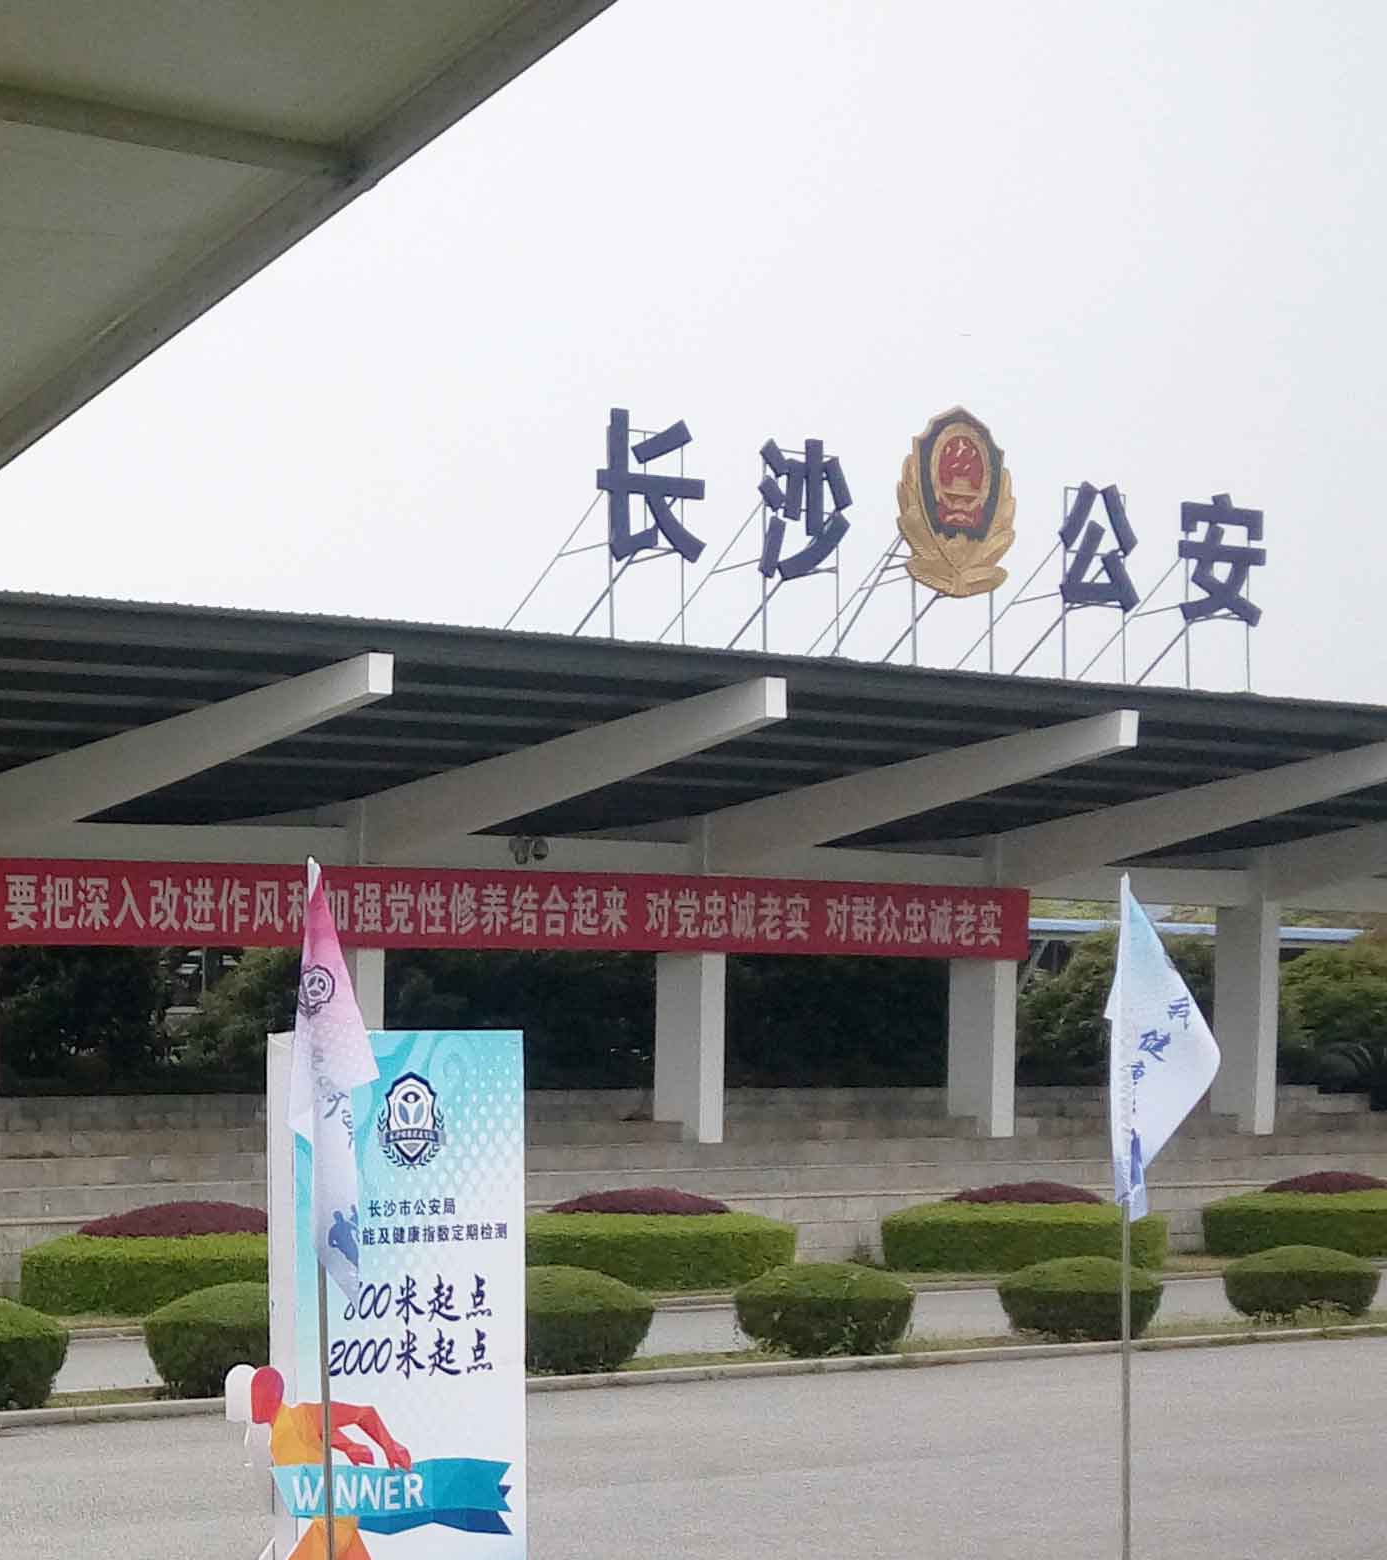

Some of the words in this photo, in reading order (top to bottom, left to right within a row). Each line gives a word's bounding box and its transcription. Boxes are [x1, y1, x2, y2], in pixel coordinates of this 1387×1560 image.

[596, 407, 851, 581] 长沙
[1059, 481, 1266, 628] 公安
[645, 889, 812, 940] 对党忠诚老实
[825, 896, 1003, 948] 对群众忠诚老实
[368, 1197, 456, 1218] 长沙市公安局
[358, 1222, 508, 1246] 能及健康指数定期检测
[329, 1328, 494, 1380] 2000米起点
[292, 1472, 424, 1511] WNNER
